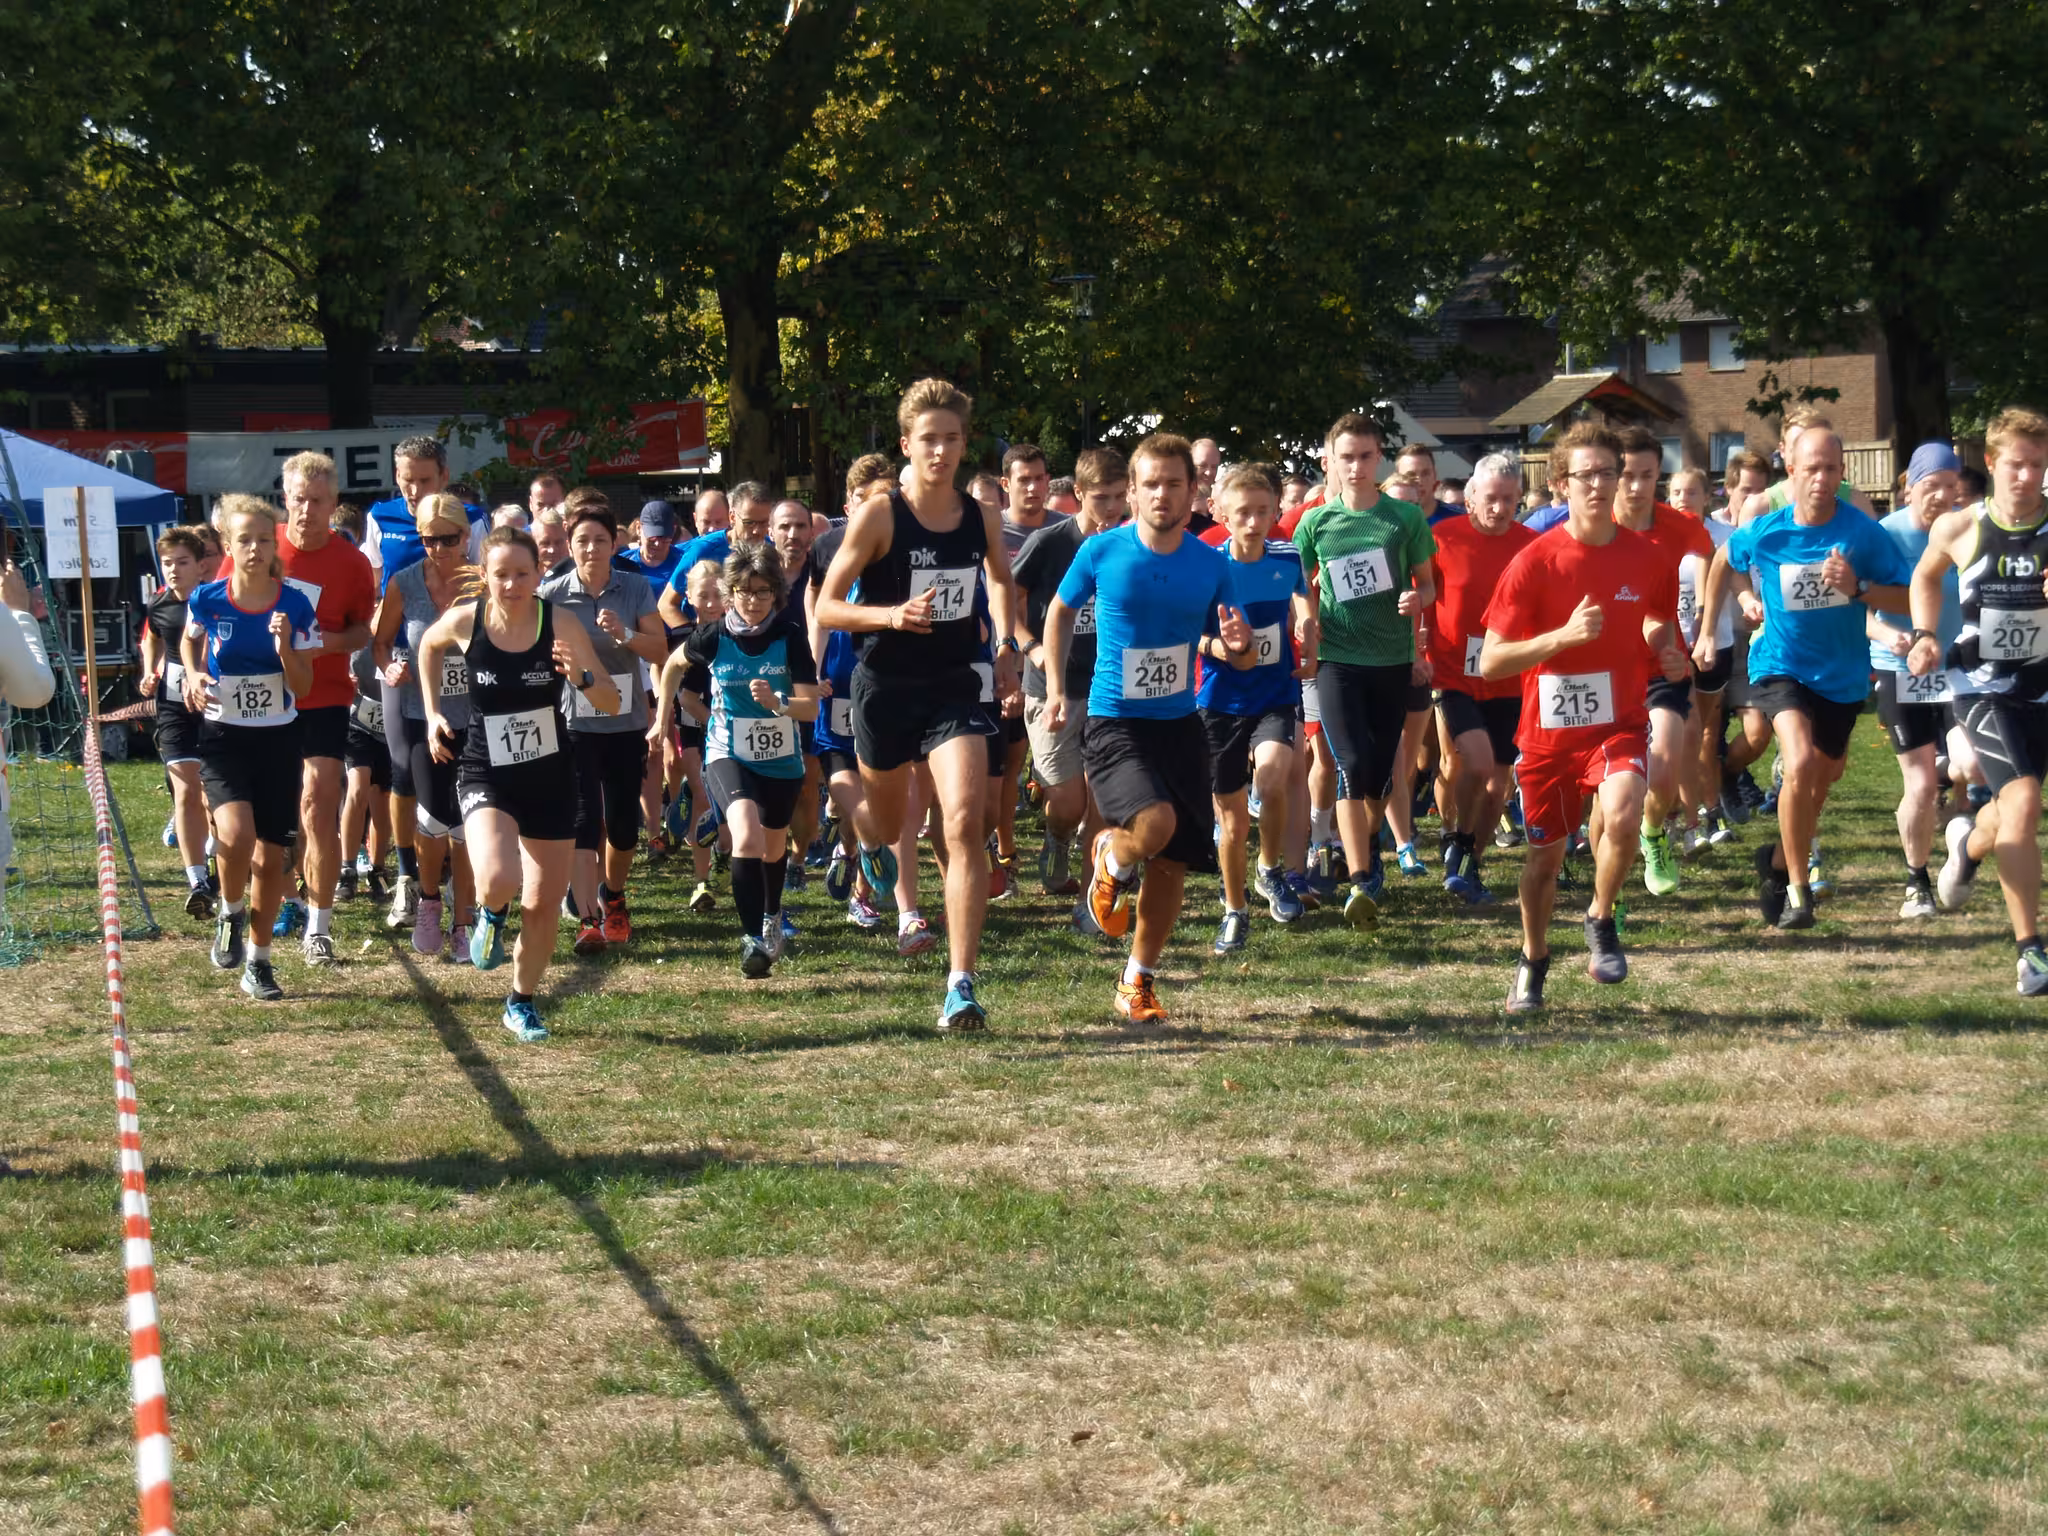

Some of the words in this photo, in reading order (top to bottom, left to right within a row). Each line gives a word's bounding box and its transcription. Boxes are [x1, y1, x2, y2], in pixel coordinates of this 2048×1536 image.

[273, 444, 398, 490] ZE
[1342, 565, 1378, 590] 151
[1353, 584, 1377, 598] BITel
[1791, 579, 1836, 601] 232
[1074, 624, 1097, 634] BITe
[1991, 626, 2042, 649] 207
[440, 669, 469, 687] 88
[1134, 663, 1178, 688] 248
[1906, 674, 1946, 694] 245
[231, 689, 273, 710] 182
[1145, 686, 1172, 697] BITel
[241, 707, 267, 719] BITel
[1551, 691, 1599, 716] 215
[1563, 714, 1592, 726] BITel
[500, 726, 543, 753] 171
[744, 731, 784, 752] 198
[513, 747, 541, 763] BITel
[753, 750, 779, 761] BITel
